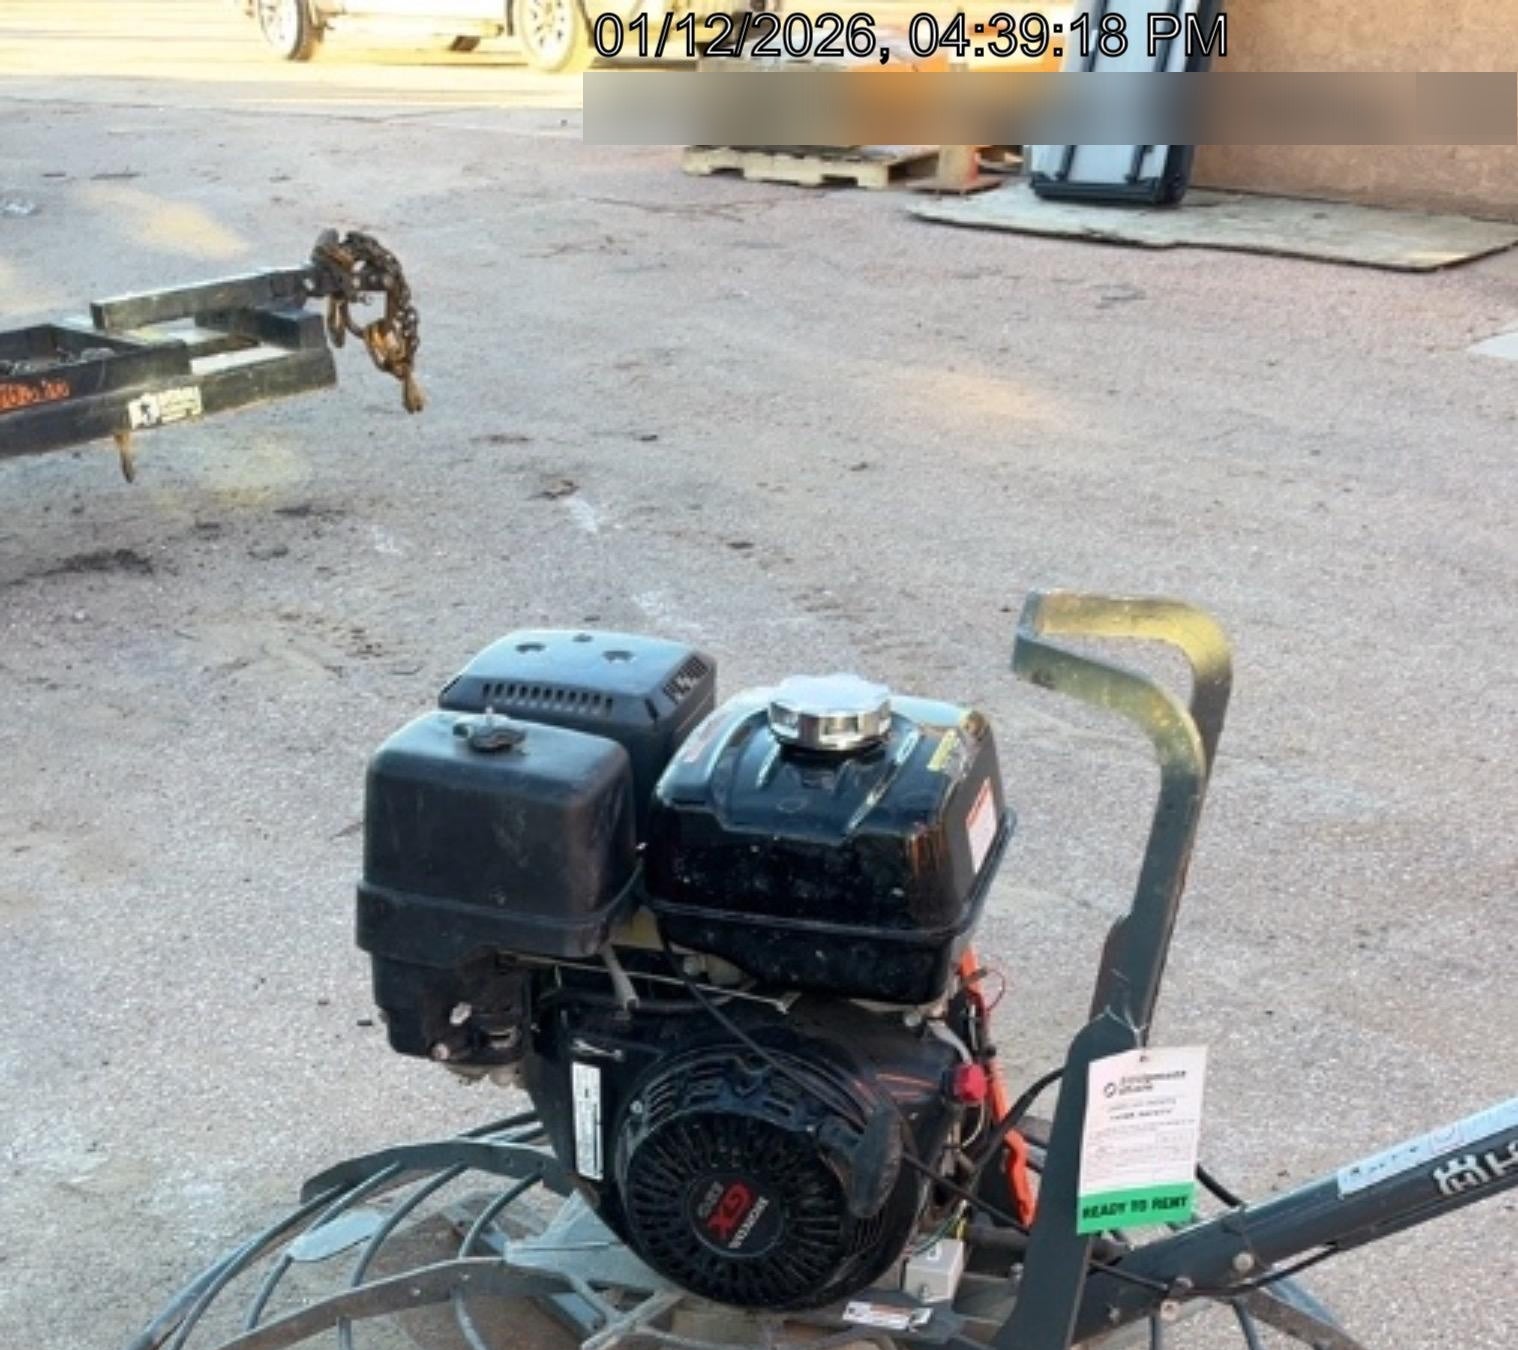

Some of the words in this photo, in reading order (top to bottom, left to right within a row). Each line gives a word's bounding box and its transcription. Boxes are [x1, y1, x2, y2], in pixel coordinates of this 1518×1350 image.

[705, 1180, 752, 1240] GX
[1083, 1202, 1126, 1219] READY
[1130, 1198, 1147, 1213] TO
[1151, 1195, 1189, 1210] RENT
